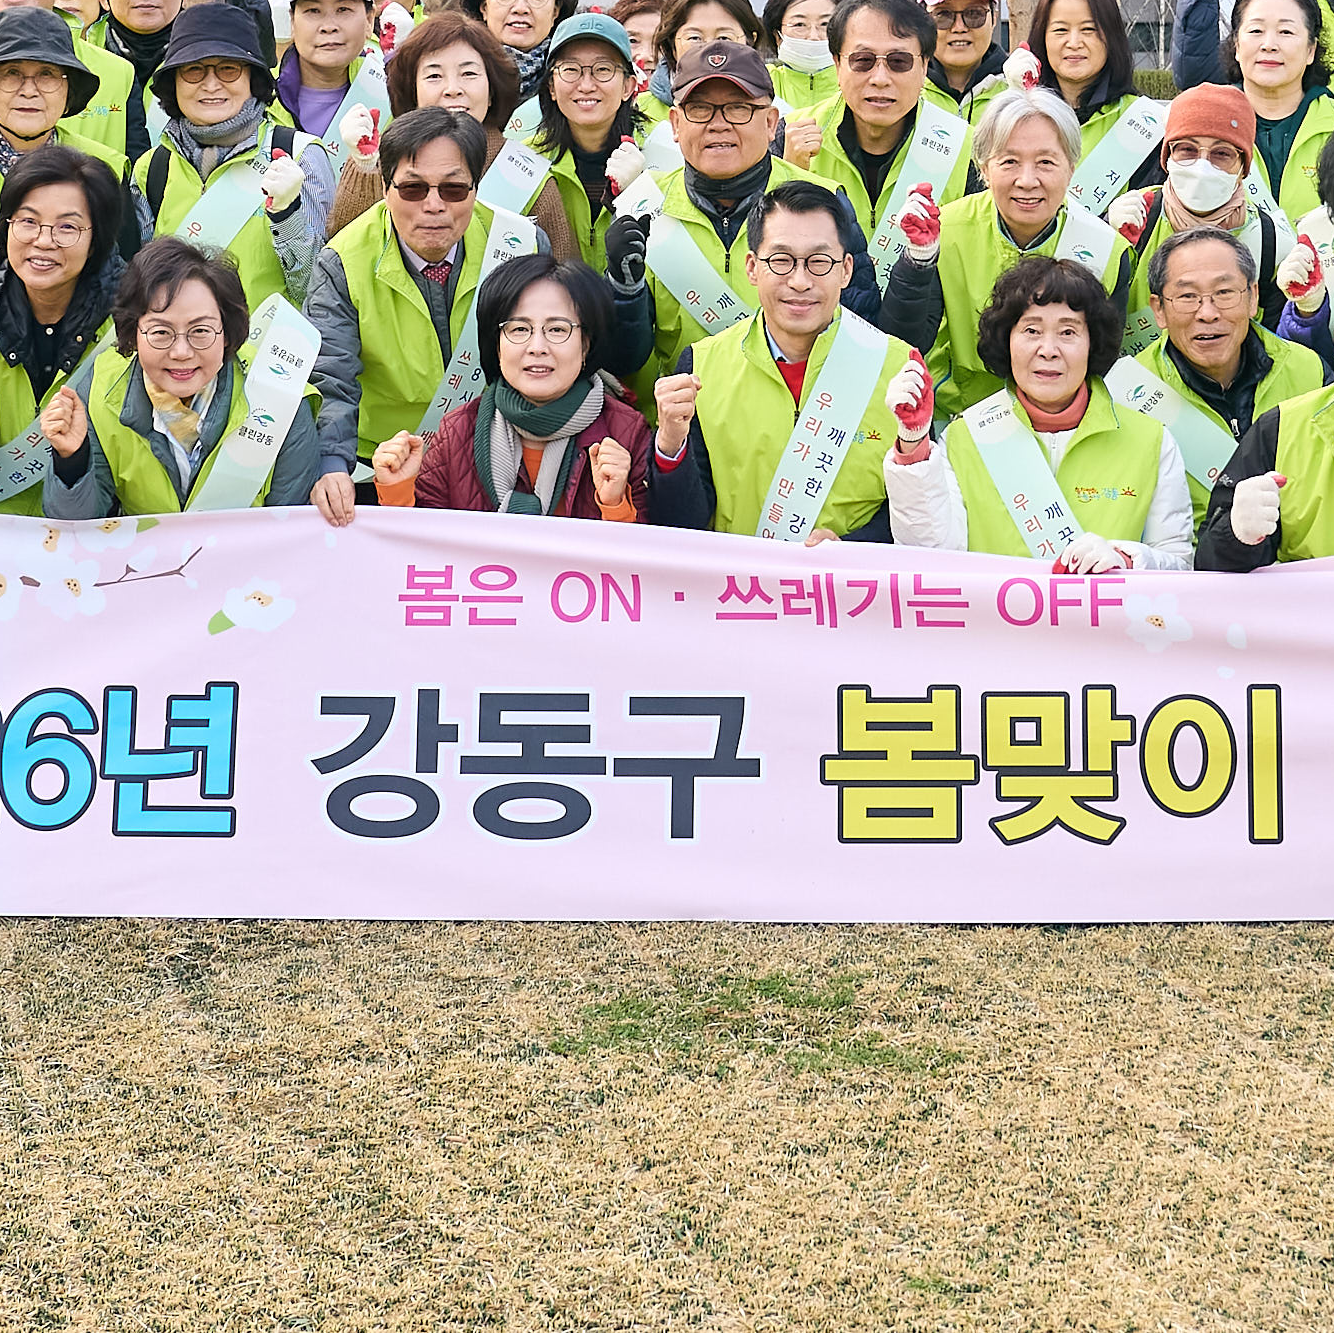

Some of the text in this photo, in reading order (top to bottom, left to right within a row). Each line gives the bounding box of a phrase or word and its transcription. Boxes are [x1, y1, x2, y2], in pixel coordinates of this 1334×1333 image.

[245, 158, 269, 175] 클린강
[920, 137, 953, 157] 클린강동
[684, 289, 722, 326] 우리
[438, 349, 473, 414] 쓰레기
[237, 424, 275, 446] 클린강동
[793, 391, 834, 463] 우리가
[803, 425, 848, 499] 깨끗한
[1010, 492, 1056, 559] 우리가
[1043, 500, 1076, 545] 깨끗
[399, 564, 523, 627] 봄은
[550, 570, 641, 623] ON
[716, 574, 970, 629] 쓰레기는
[996, 576, 1126, 628] OFF
[309, 687, 762, 840] 강동구
[820, 684, 1283, 845] 봄맞이
